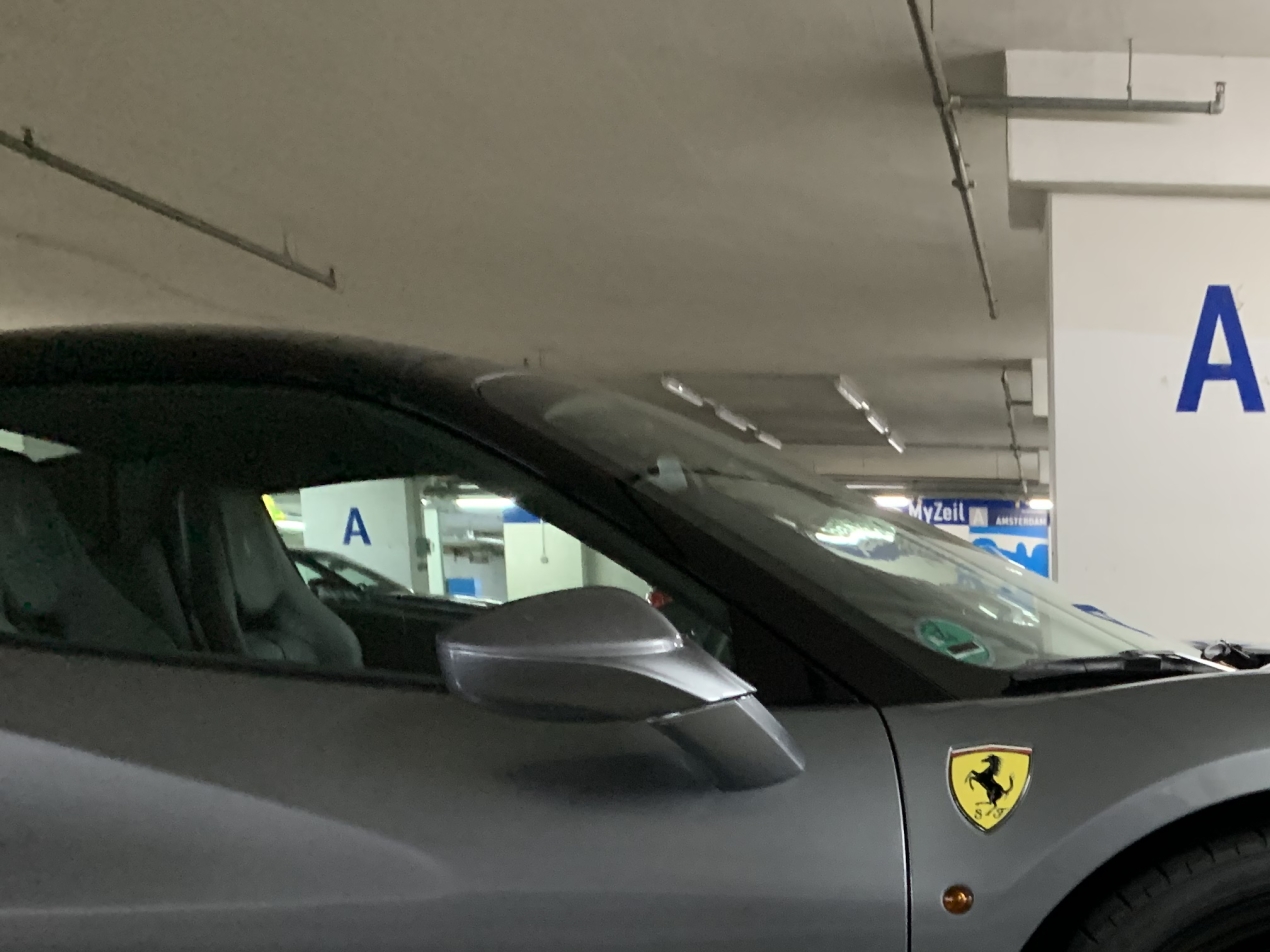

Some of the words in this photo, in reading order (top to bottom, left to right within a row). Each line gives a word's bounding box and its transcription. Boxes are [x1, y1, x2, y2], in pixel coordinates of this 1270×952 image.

[1176, 284, 1265, 413] A
[343, 507, 372, 546] A
[908, 499, 966, 525] MyZeil
[995, 516, 1047, 526] AMSTERDAM
